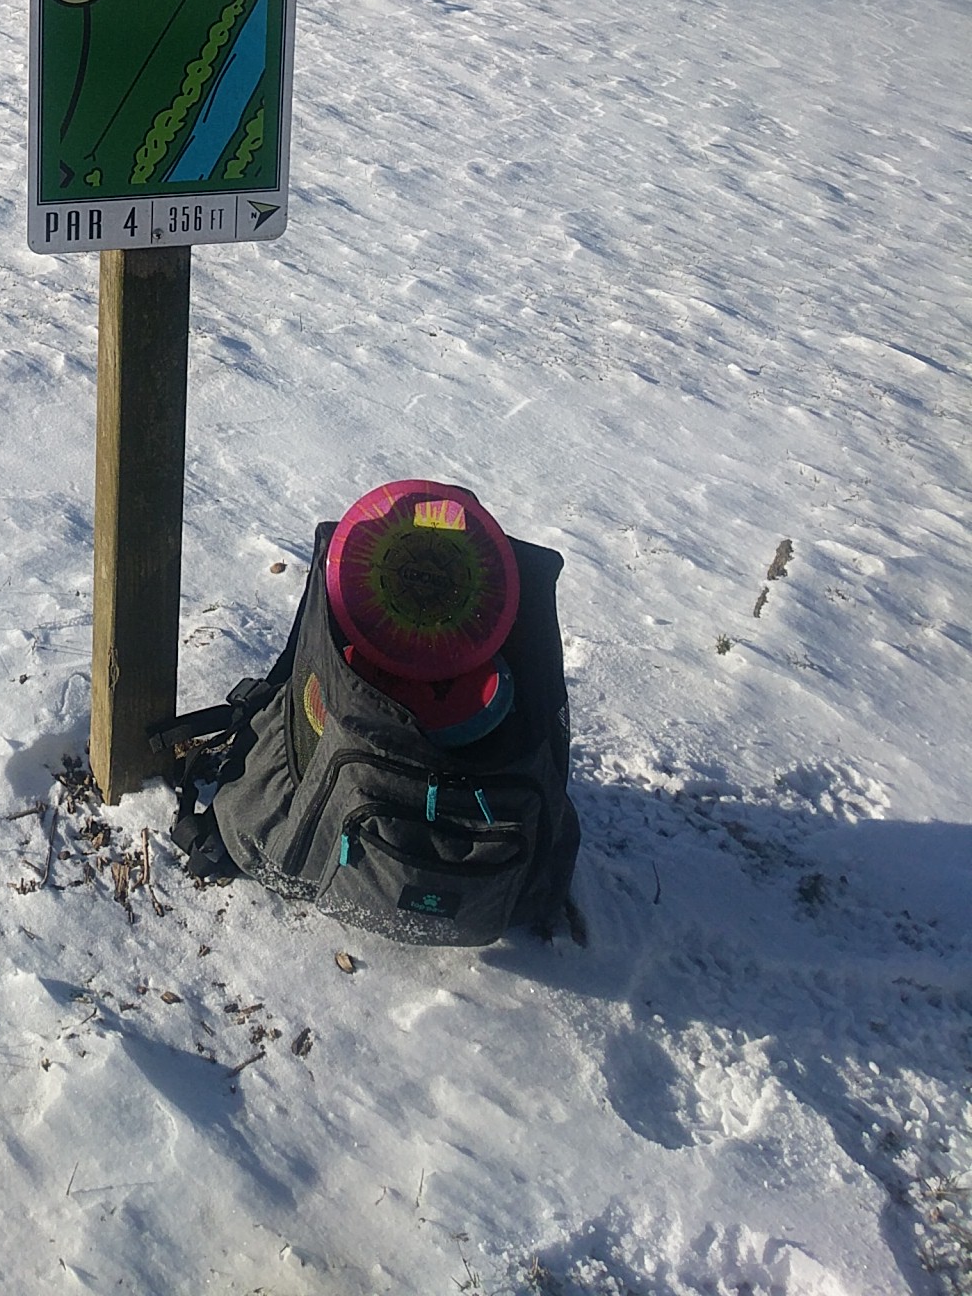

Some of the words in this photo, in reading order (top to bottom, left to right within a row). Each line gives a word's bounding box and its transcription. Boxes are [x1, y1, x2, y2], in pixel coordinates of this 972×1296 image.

[45, 209, 102, 242] PAR
[123, 207, 138, 237] 4
[169, 206, 202, 232] 356
[210, 208, 224, 230] FT
